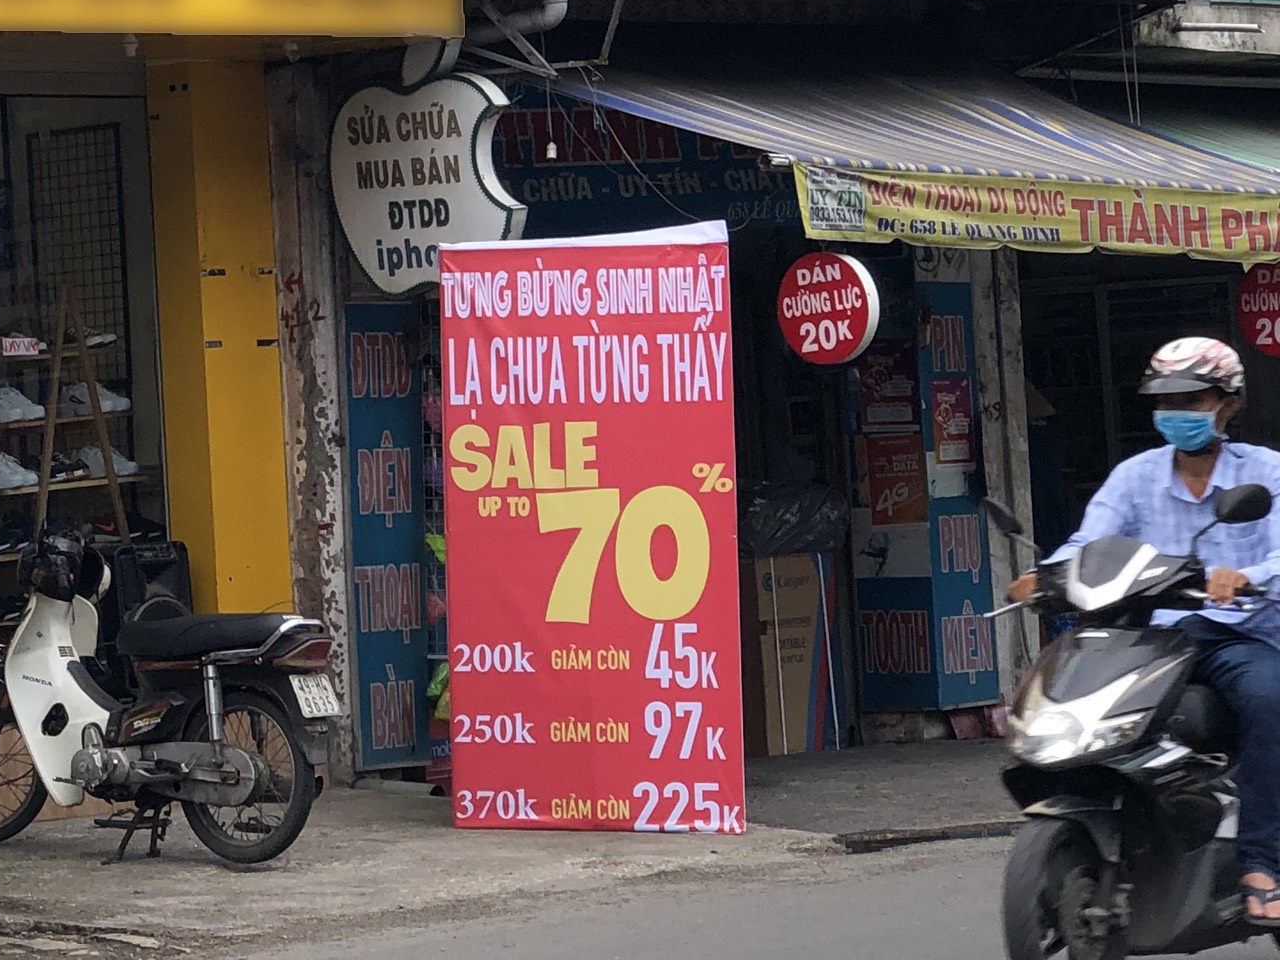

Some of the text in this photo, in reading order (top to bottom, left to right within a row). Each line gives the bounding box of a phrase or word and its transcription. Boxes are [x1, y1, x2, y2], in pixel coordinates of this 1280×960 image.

[347, 102, 462, 145] SỬA CHỮA
[356, 148, 461, 189] MUA BÁN
[388, 198, 450, 230] ĐTDĐ
[867, 175, 918, 213] ĐIỆN
[923, 184, 982, 219] THOẠI
[987, 186, 1009, 214] DI
[1015, 182, 1067, 222] ĐỘNG
[1070, 189, 1210, 249] THÀNH
[909, 218, 937, 236] 658
[966, 224, 1017, 241] QUANG
[517, 257, 592, 316] BỪNG
[596, 268, 653, 316] SINH
[797, 261, 842, 286] DÁN
[782, 286, 863, 320] CƯỜNG LỰC
[800, 315, 853, 354] 20K
[931, 315, 966, 372] PIN
[448, 312, 728, 420] LẠ CHƯA TỪNG THẤY
[449, 420, 600, 493] SALE
[357, 430, 412, 528] ĐIỆN
[875, 482, 910, 517] 4G
[478, 497, 500, 518] UP
[503, 496, 530, 518] TO
[938, 514, 981, 585] PHỤ
[354, 563, 421, 644] THOẠI
[454, 642, 536, 675] 200k
[551, 643, 594, 672] GIẢM
[597, 645, 630, 672] CÒN
[862, 610, 931, 674] TOOTH
[941, 600, 994, 685] KIỆN
[22, 674, 53, 687] HONDA
[370, 664, 414, 750] BÀN
[454, 712, 536, 745] 250k
[550, 713, 593, 744] GIẢM
[596, 716, 629, 744] CÒN
[455, 788, 538, 821] 370k
[550, 790, 594, 821] GIẢM
[596, 792, 630, 821] CÒN
